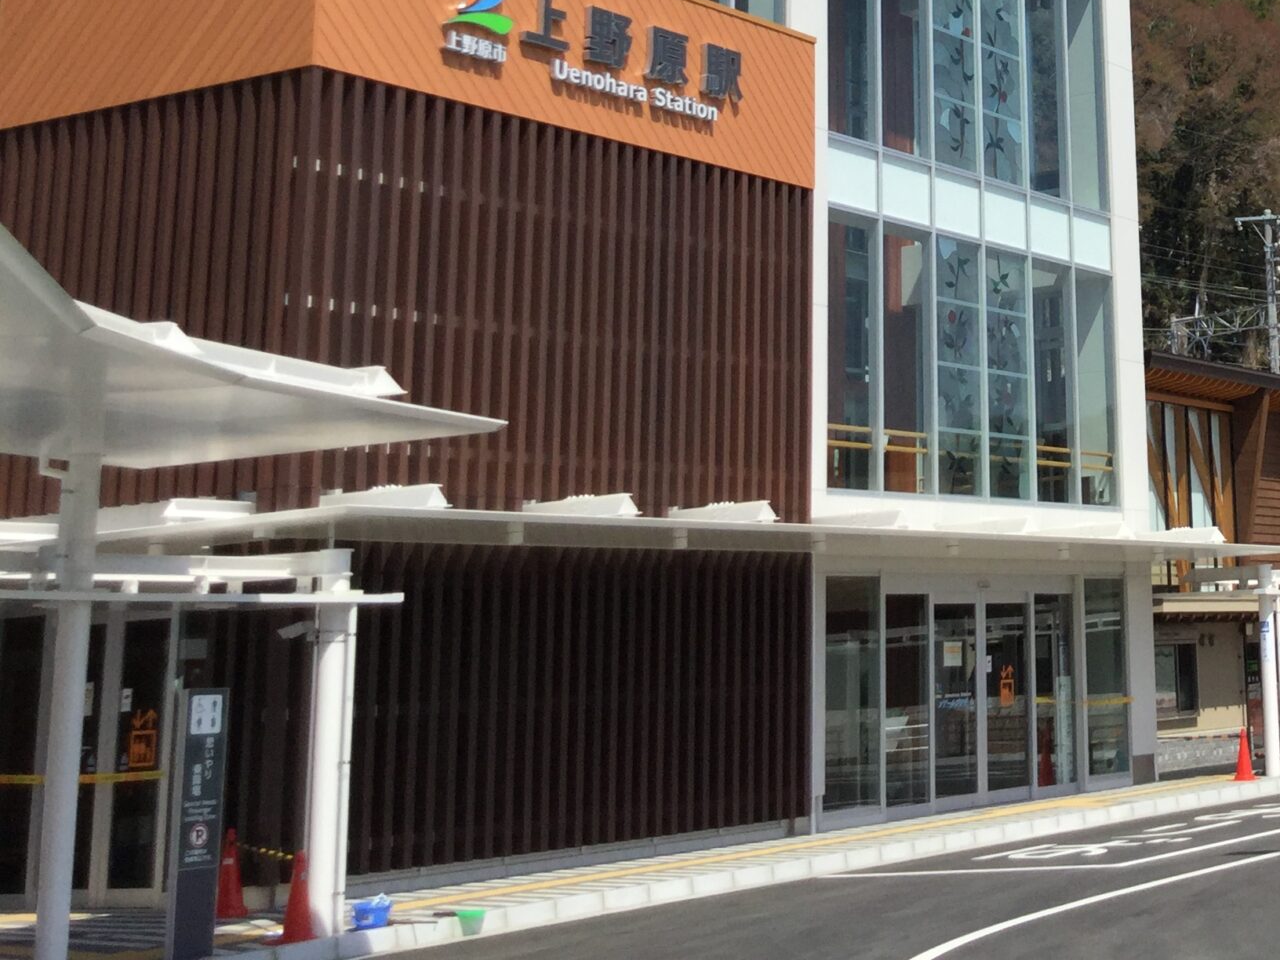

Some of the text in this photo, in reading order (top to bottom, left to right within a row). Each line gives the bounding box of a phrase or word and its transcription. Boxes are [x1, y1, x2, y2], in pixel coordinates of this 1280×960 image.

[445, 30, 508, 63] 上野原市
[553, 58, 719, 122] Uenohara Station
